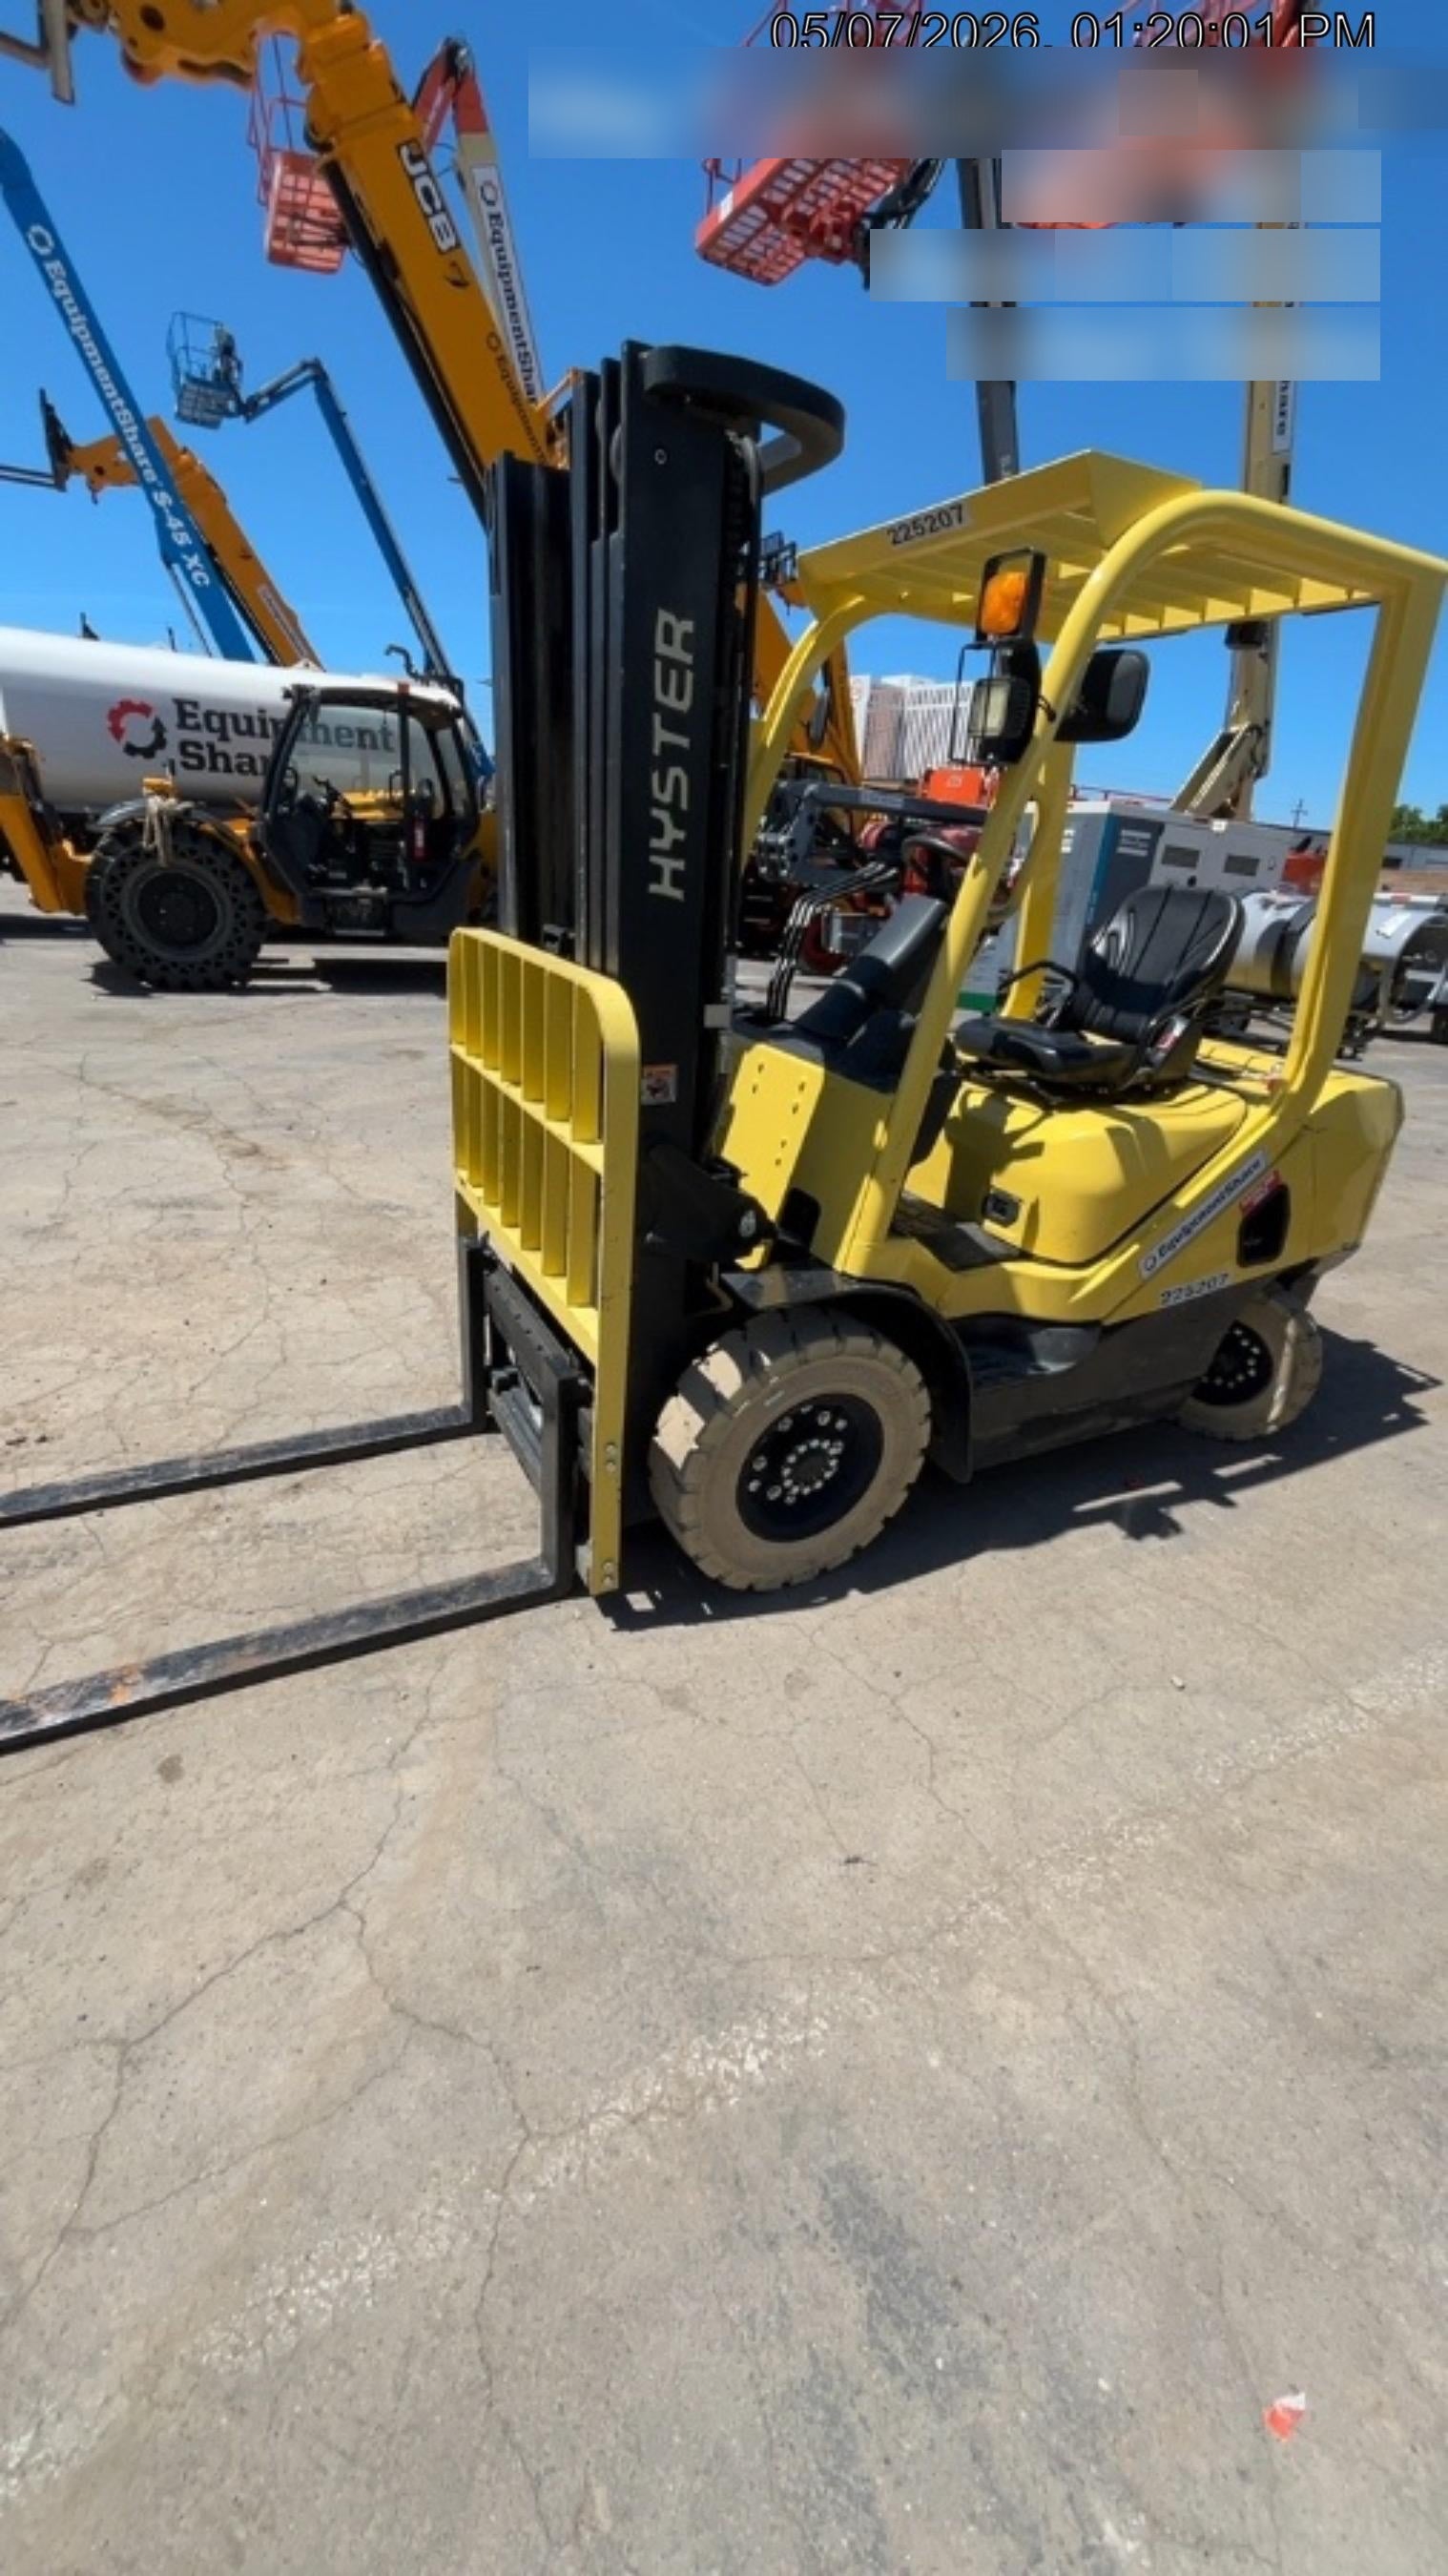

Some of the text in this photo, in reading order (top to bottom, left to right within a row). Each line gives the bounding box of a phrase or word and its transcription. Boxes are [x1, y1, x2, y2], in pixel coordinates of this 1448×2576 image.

[399, 142, 460, 254] JCB
[487, 213, 537, 404] EquipmentShar
[44, 259, 158, 483] EquipmentShare
[181, 551, 211, 588] XC
[886, 503, 962, 545] 225207
[179, 740, 273, 776] Shar
[648, 608, 694, 902] HYSTER
